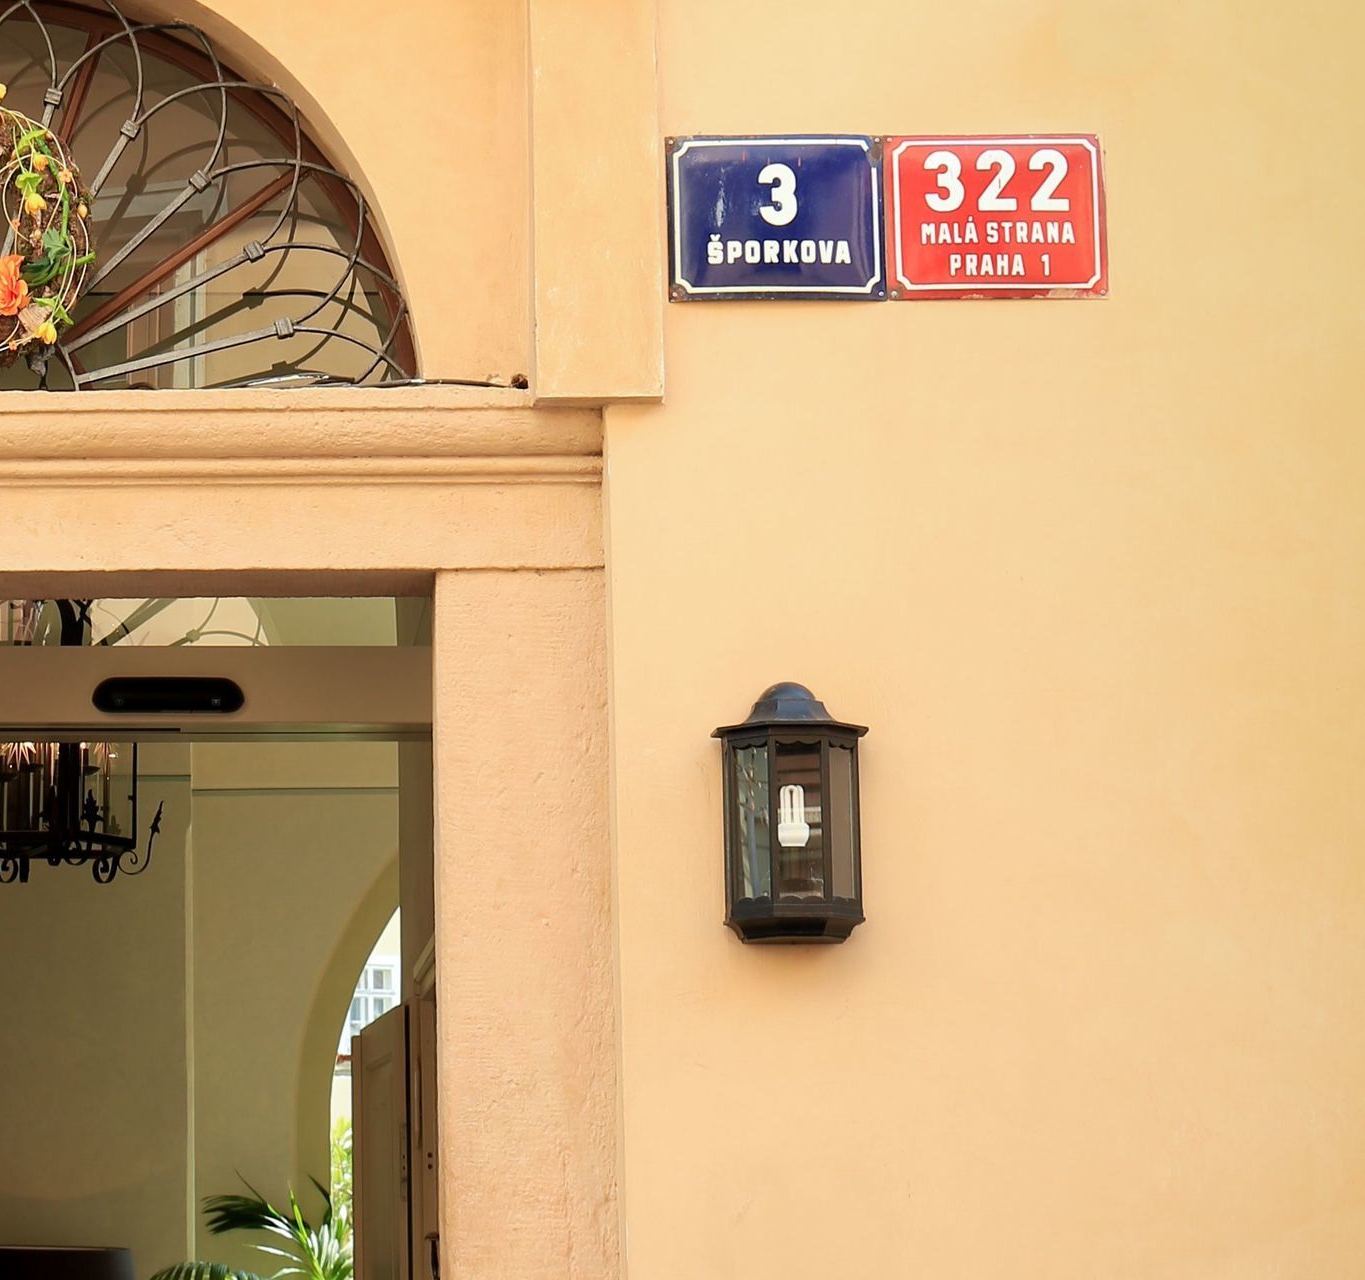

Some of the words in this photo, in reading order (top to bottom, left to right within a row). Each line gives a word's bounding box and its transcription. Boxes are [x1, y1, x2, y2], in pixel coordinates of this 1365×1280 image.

[757, 163, 798, 227] 3
[922, 149, 1070, 212] 322
[920, 216, 977, 245] MALÁ
[986, 221, 1076, 245] STRANA
[707, 233, 852, 265] ŠPORKOVA
[949, 253, 1025, 277] PRAHA
[1040, 253, 1051, 276] 1
